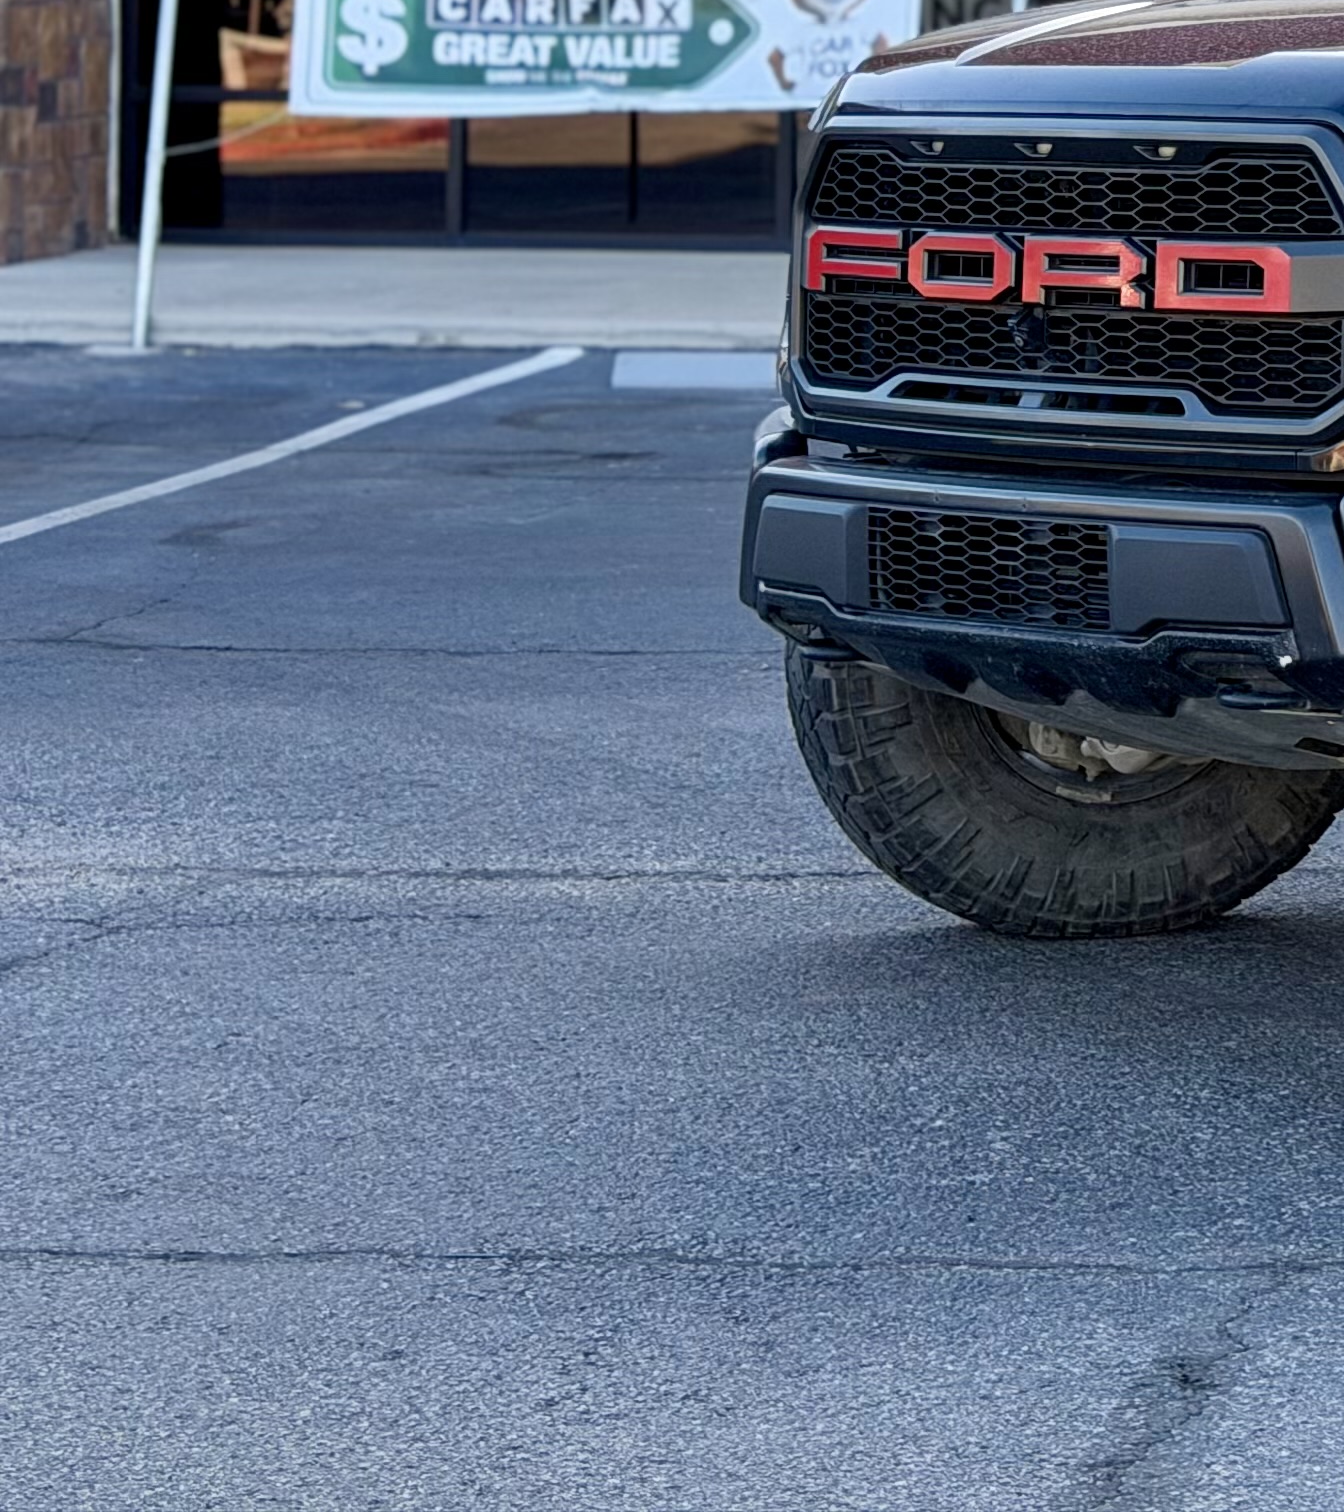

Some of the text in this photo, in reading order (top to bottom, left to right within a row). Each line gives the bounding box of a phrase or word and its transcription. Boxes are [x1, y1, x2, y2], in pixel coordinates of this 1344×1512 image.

[432, 32, 681, 68] GREAT VALUE
[807, 229, 1292, 313] FORD
